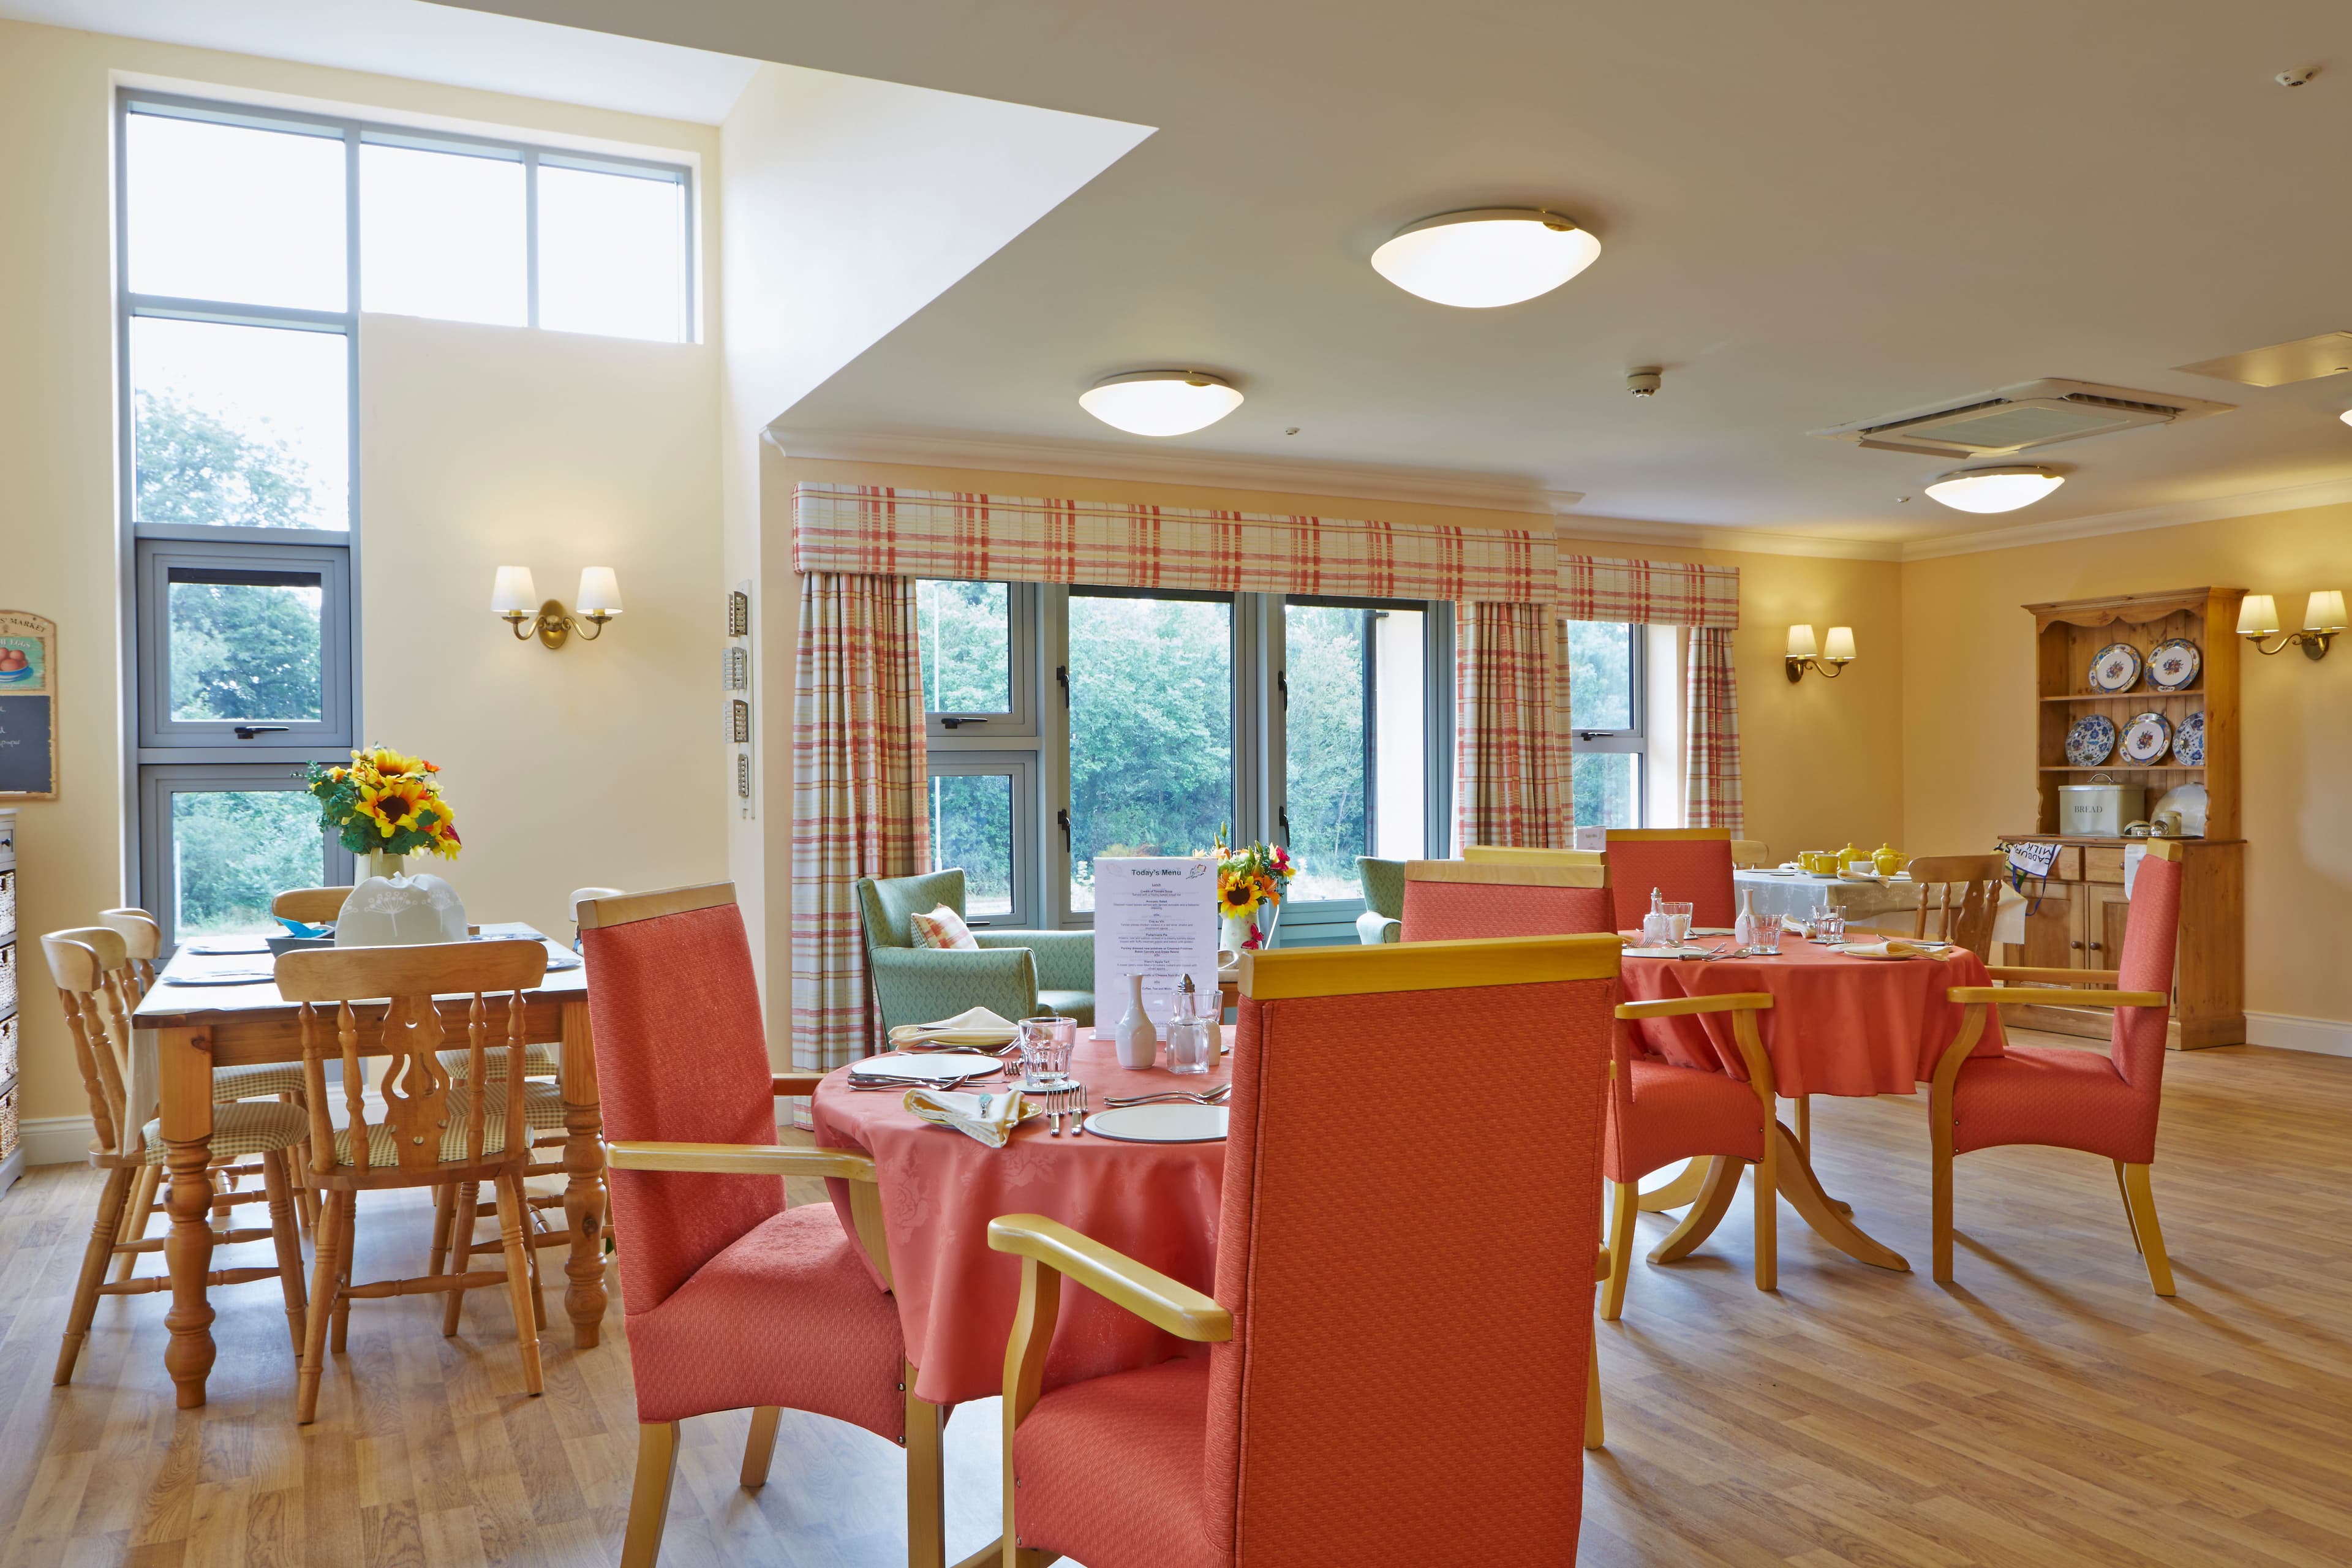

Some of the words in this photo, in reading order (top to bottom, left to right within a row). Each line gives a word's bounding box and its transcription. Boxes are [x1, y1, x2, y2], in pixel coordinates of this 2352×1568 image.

[10, 617, 47, 633] MARKET
[10, 638, 30, 649] EGGS
[2074, 805, 2103, 813] BREAD
[2026, 843, 2052, 857] MILK
